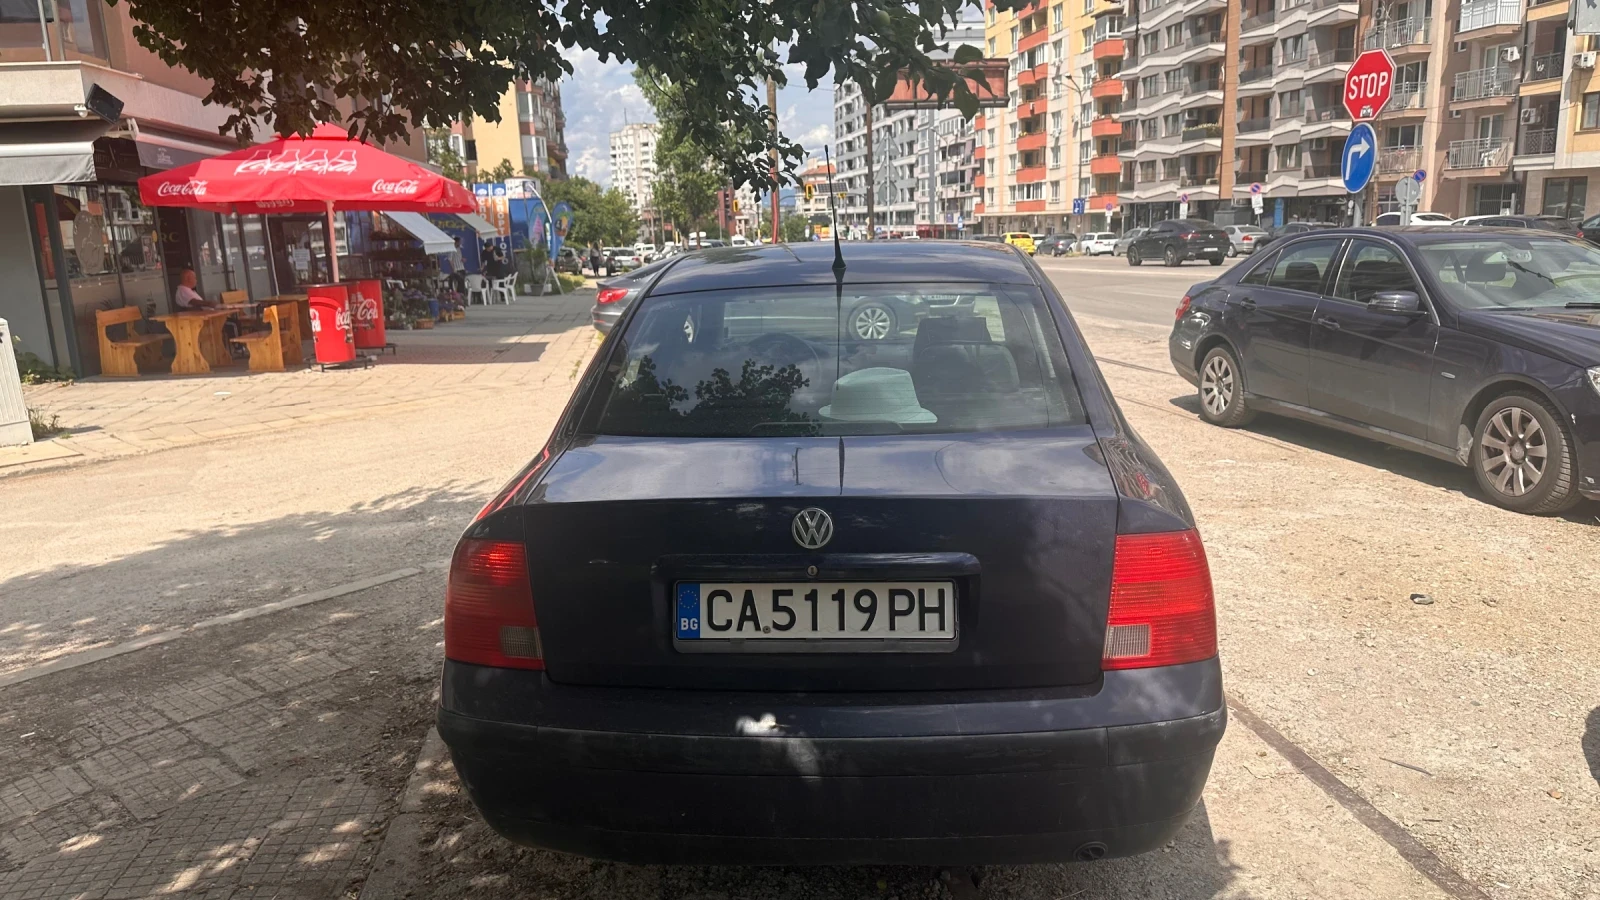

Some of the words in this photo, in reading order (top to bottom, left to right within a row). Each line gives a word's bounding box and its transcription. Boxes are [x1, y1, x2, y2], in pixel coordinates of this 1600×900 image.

[1348, 71, 1388, 100] STOP
[158, 181, 208, 197] Coca-Cola
[372, 179, 418, 194] Coca-Cola
[792, 508, 833, 549] VW
[680, 618, 698, 631] BG
